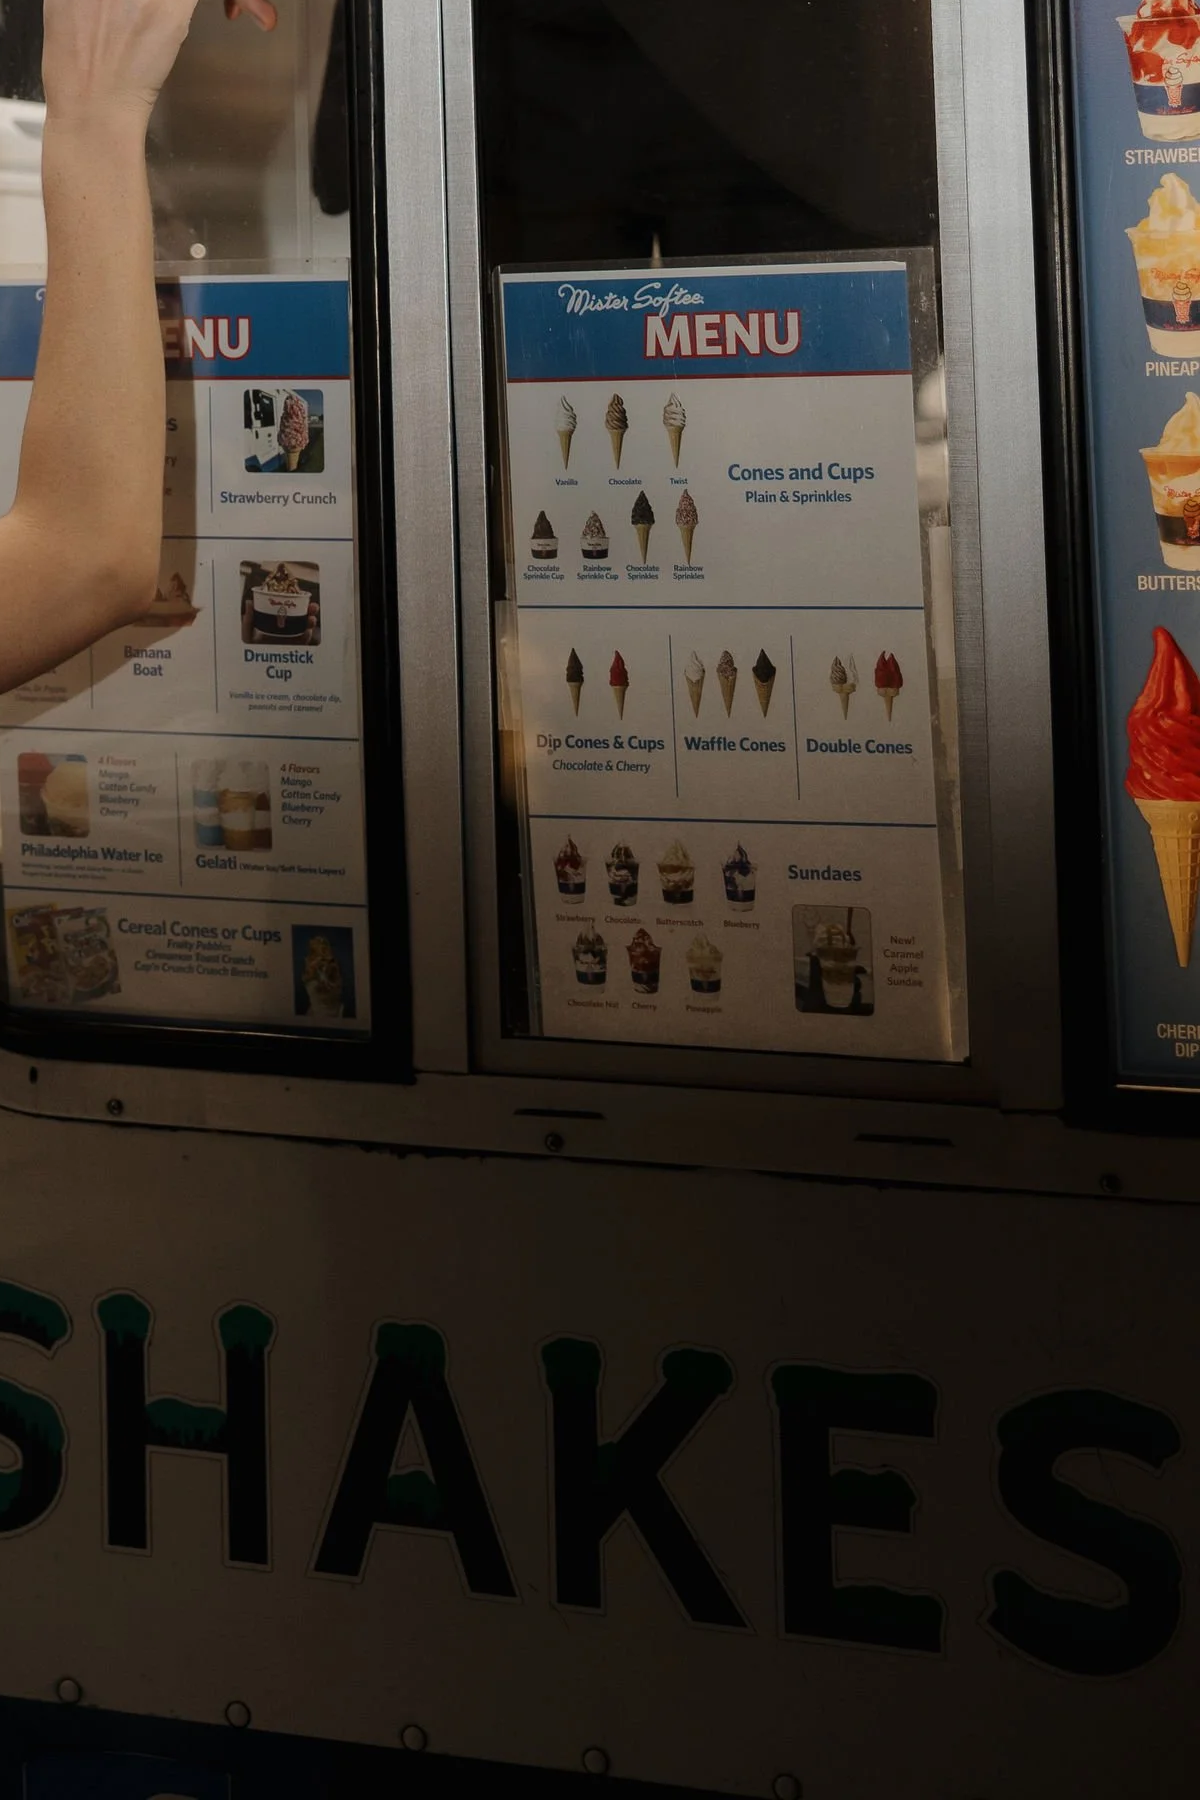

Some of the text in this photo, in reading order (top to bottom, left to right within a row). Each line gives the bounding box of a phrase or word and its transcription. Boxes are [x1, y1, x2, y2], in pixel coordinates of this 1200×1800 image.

[558, 282, 704, 317] Mister Softee
[162, 316, 252, 360] ENU
[644, 309, 801, 359] MENU
[1145, 362, 1200, 376] PINEAP
[728, 462, 875, 483] Cones and Cups
[608, 478, 642, 486] Chocolate
[669, 477, 689, 486] Twist
[220, 491, 337, 505] Strawberry Crunch
[745, 490, 852, 504] Plain & Sprinkles
[527, 564, 560, 572] Chocolate
[583, 564, 612, 572] Rainbow
[626, 564, 660, 572] Chocolate
[674, 564, 703, 572] Rainbow
[523, 572, 565, 581] Sprinkle Cup
[576, 572, 619, 581] Sprinkle Cup
[628, 572, 659, 581] Sprinkles
[673, 572, 705, 581] Sprinkles
[1137, 575, 1200, 591] BUTTERS
[124, 645, 172, 660] Banana
[244, 648, 314, 665] Drumstick
[133, 663, 163, 677] Boat
[266, 665, 293, 682] Cup
[536, 734, 665, 753] Dip Cones & Cups
[684, 736, 786, 752] Waffle Cones
[806, 739, 913, 754] Double Cones
[552, 759, 651, 774] Chocolate & Cherry
[281, 790, 312, 800] Cotton
[21, 843, 164, 863] Philadelphia Water Ice
[195, 855, 238, 870] Gelati
[788, 864, 862, 882] Sundaes
[117, 918, 282, 945] Cereal Cones or Cups
[883, 949, 924, 959] Caramel
[890, 963, 919, 974] Apple
[887, 976, 924, 987] Sundae
[1175, 1042, 1200, 1058] DIP
